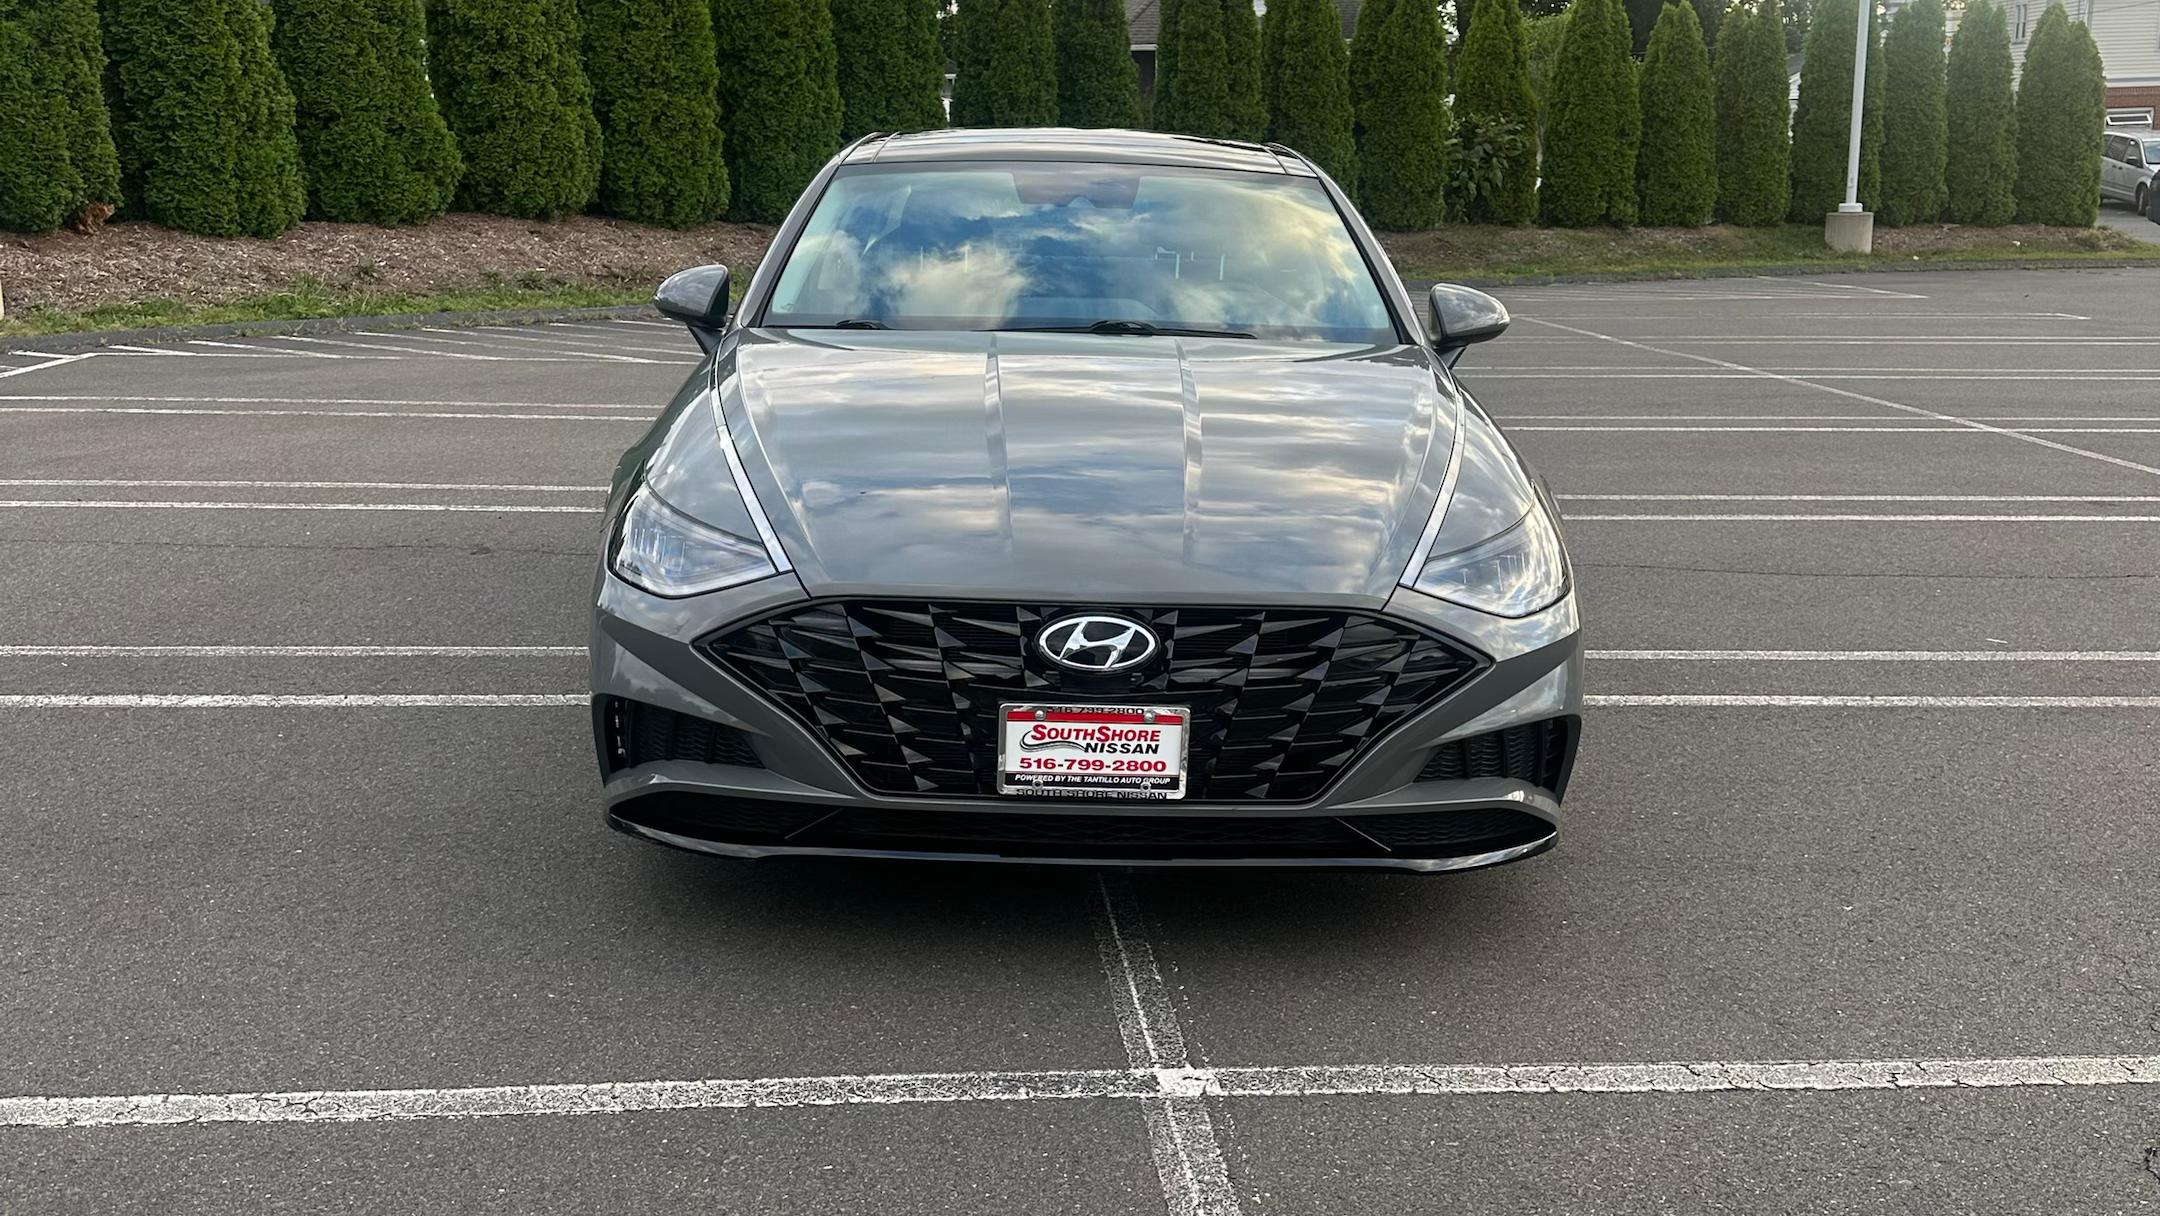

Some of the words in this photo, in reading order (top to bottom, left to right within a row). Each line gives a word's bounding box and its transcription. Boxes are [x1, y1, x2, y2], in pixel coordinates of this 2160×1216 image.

[1084, 742, 1159, 754] NISSAN
[1019, 758, 1167, 772] 516-799-2800
[1084, 776, 1120, 784] TANTILLO
[1066, 789, 1114, 798] SHORE
[1117, 791, 1167, 799] NISSAN
